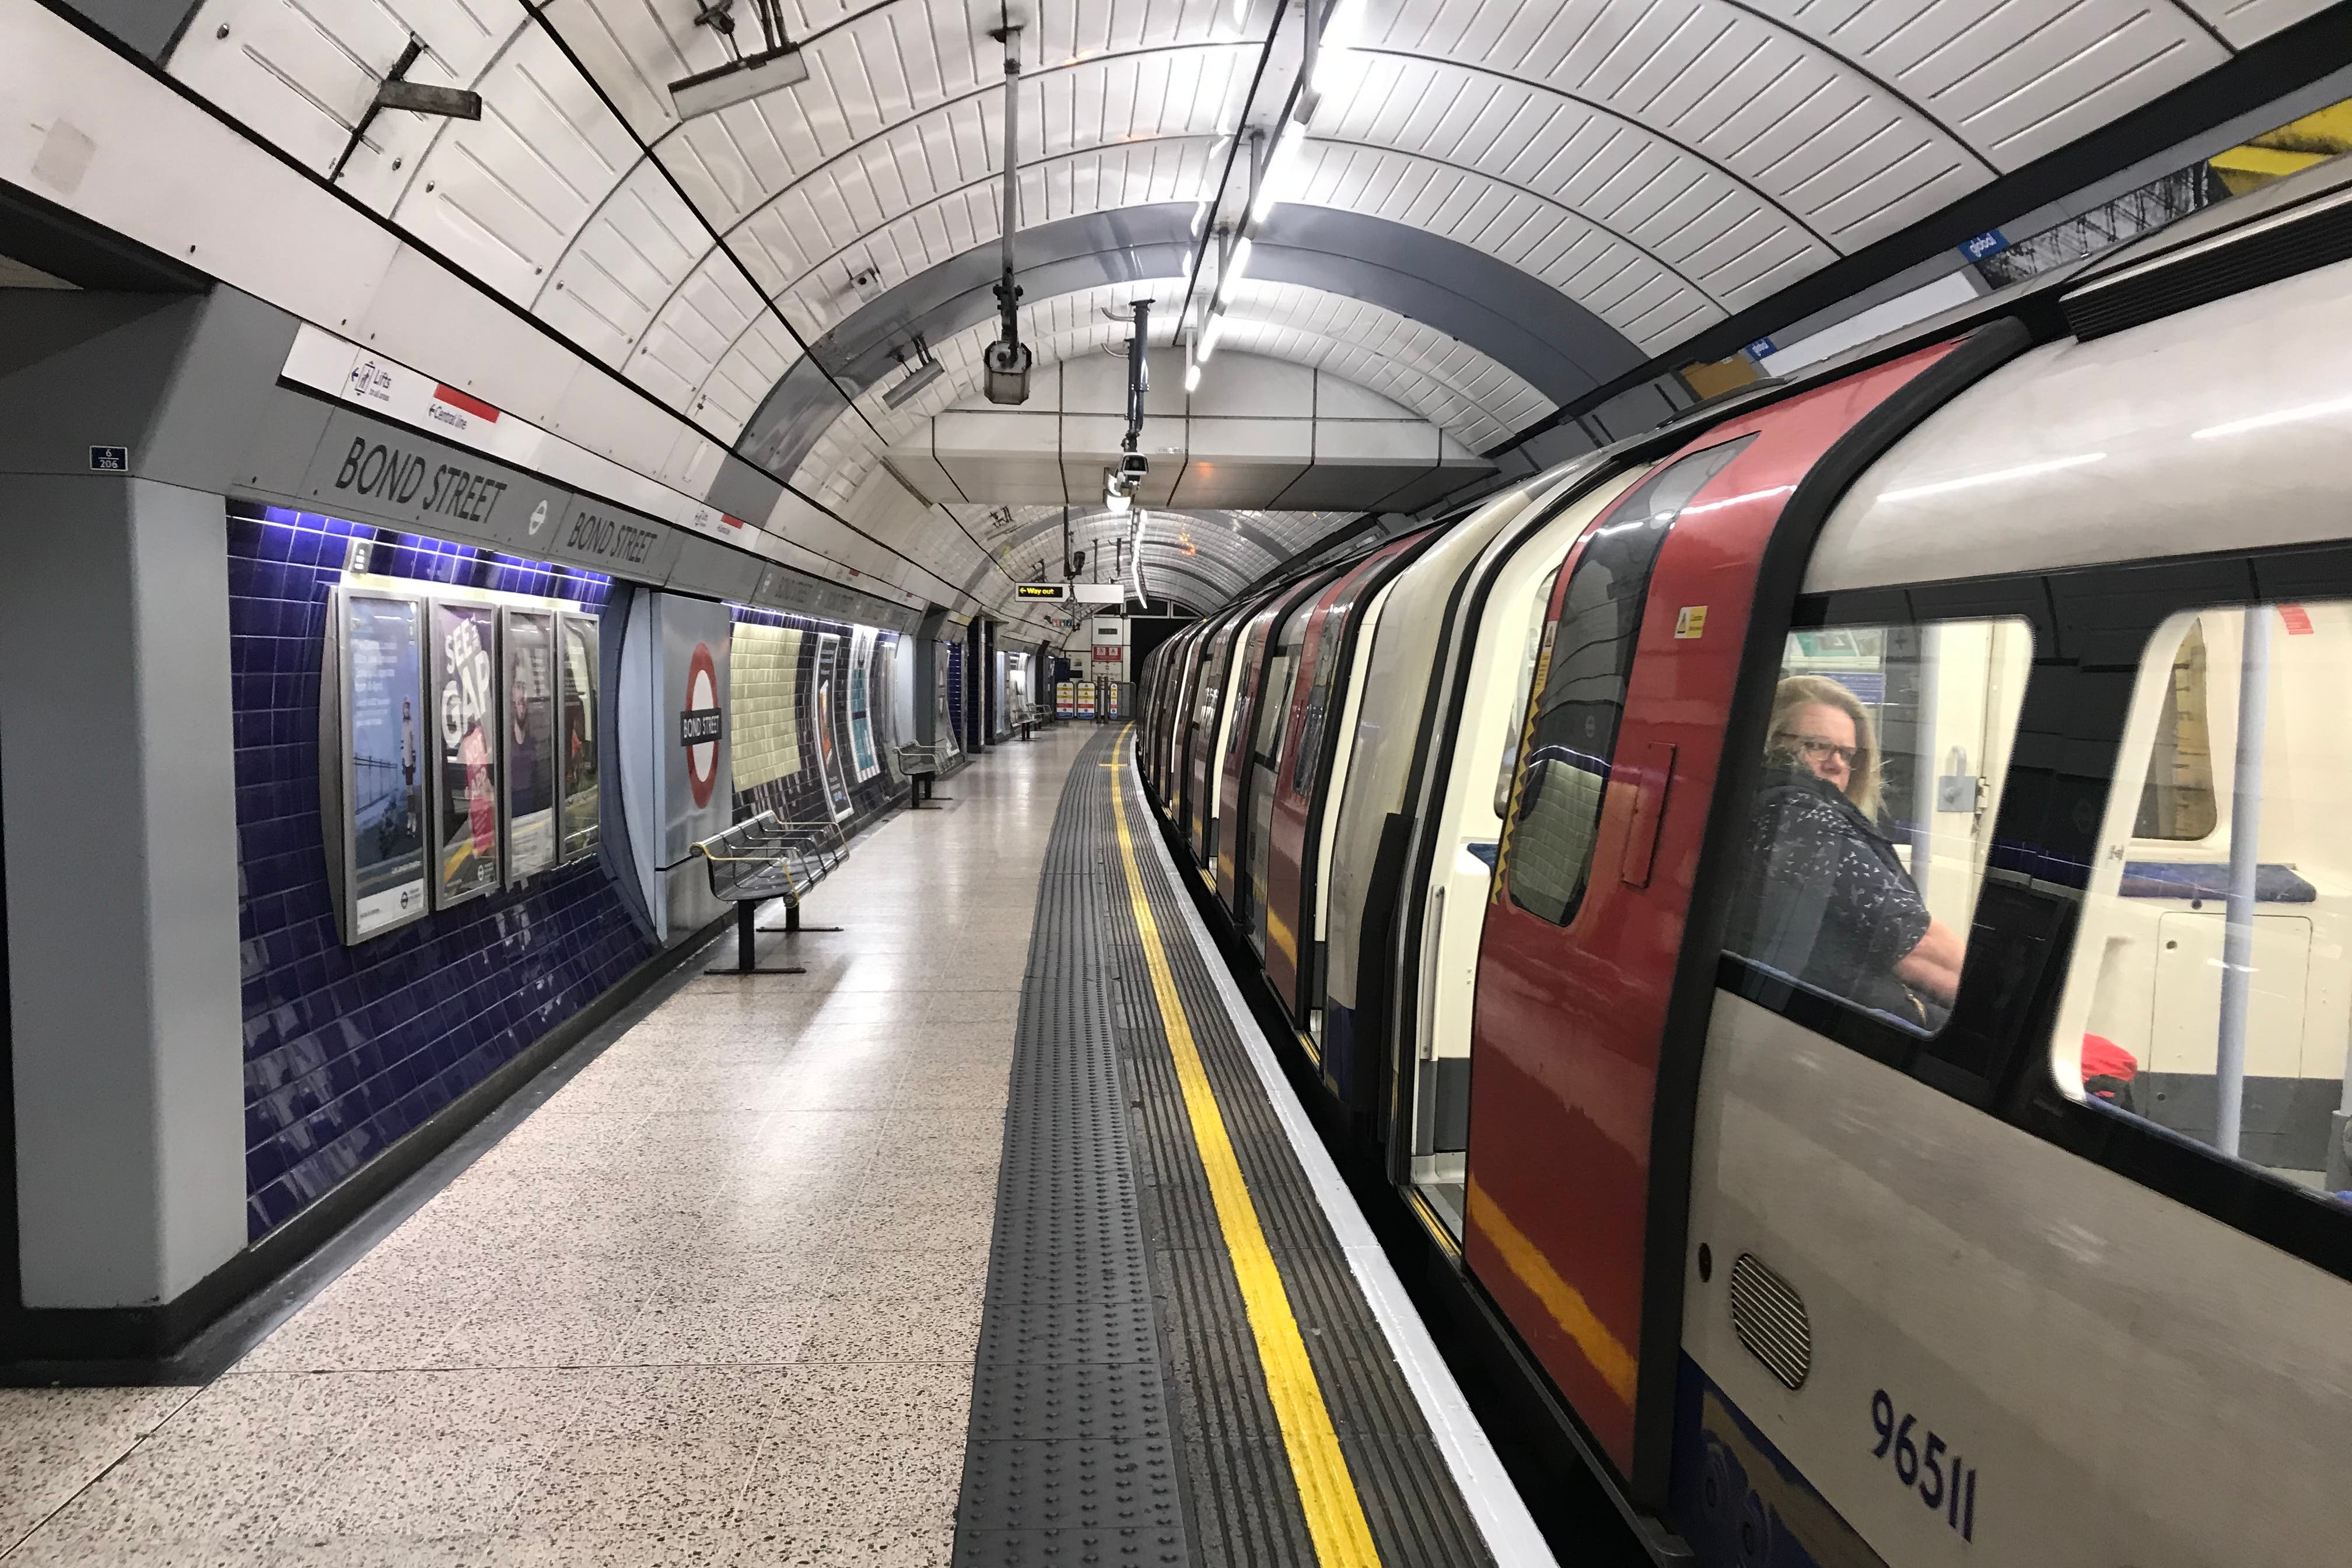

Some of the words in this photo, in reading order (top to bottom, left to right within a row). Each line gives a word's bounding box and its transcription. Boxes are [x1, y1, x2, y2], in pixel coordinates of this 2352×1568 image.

[100, 460, 118, 468] 206
[106, 449, 112, 457] 6
[334, 436, 426, 503] BOND
[422, 464, 508, 524] STREET
[567, 512, 615, 554] BOND
[610, 524, 657, 564] STREET
[1027, 587, 1041, 596] Way
[684, 718, 701, 738] BOND
[702, 715, 719, 735] STREET
[1870, 1388, 1976, 1545] 96511
